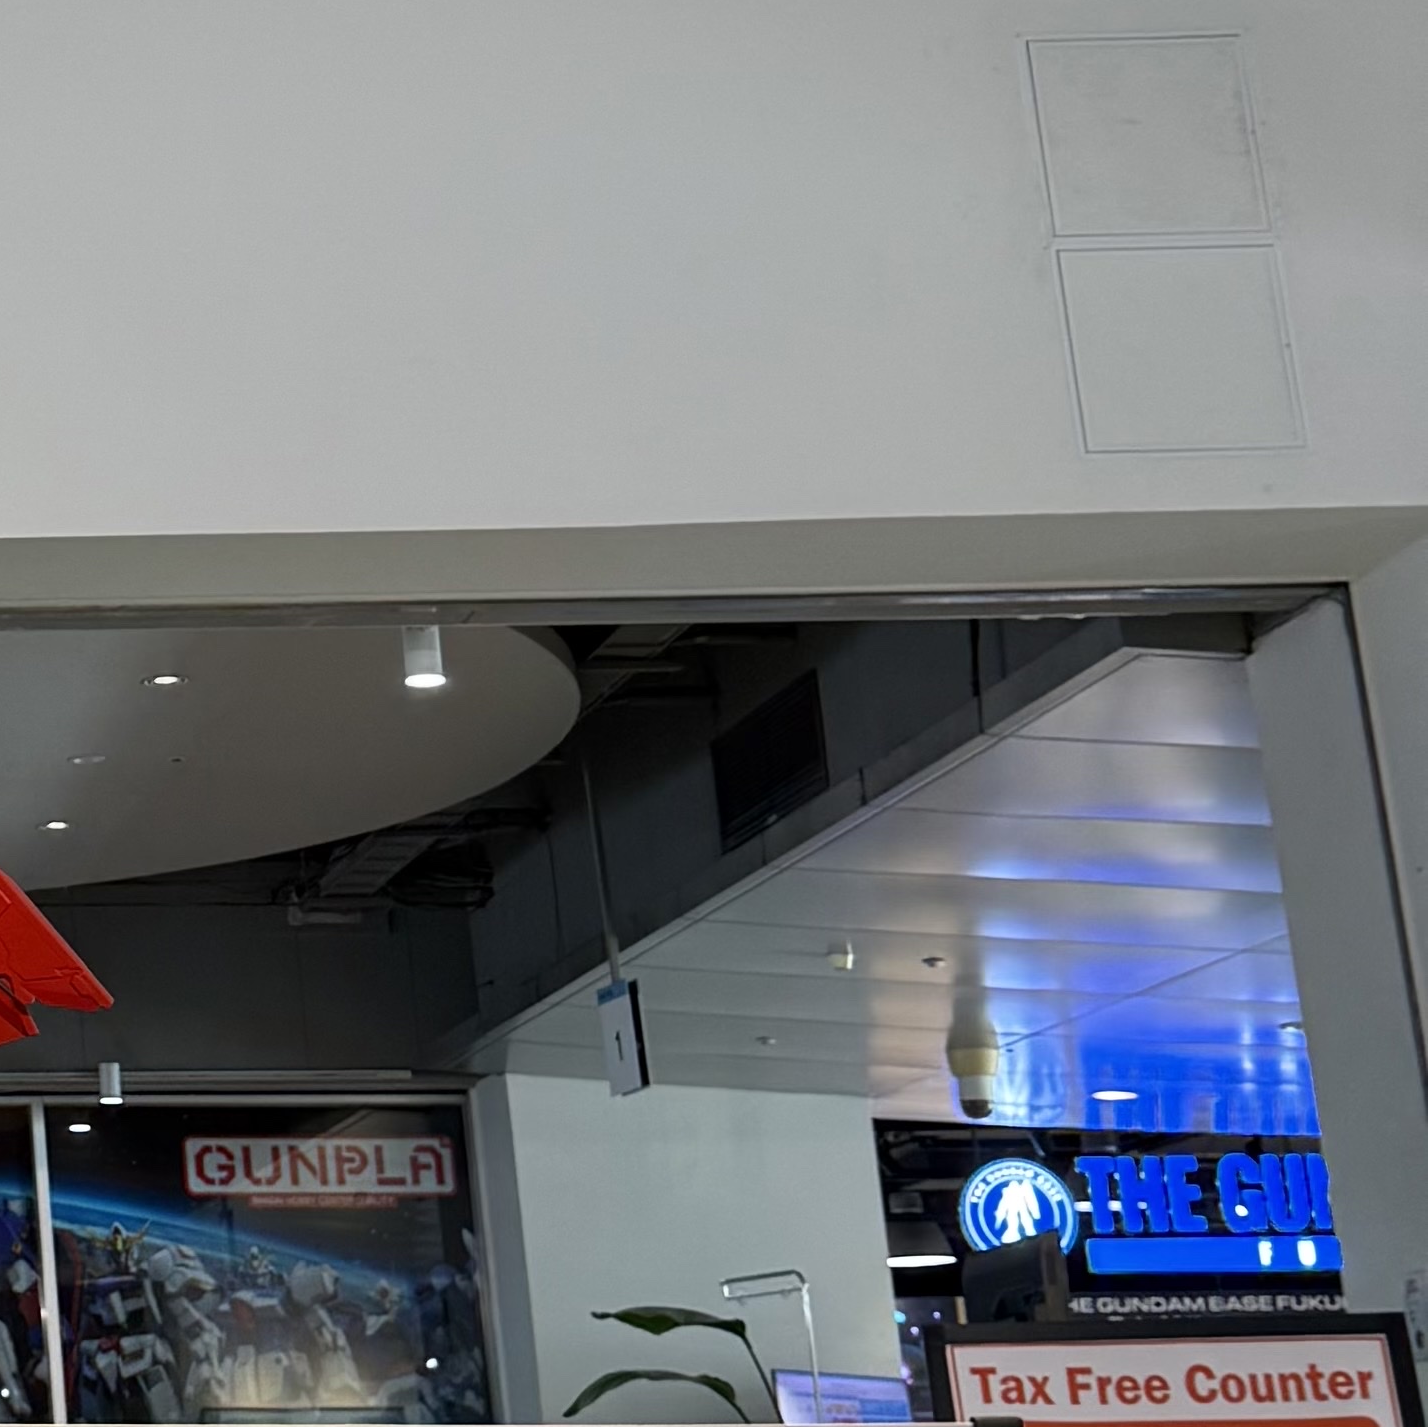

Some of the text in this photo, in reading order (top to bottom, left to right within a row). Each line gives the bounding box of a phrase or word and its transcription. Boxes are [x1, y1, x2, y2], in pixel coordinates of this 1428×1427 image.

[194, 1143, 445, 1187] GUNPLA
[1074, 1154, 1209, 1234] THE
[1096, 1296, 1207, 1314] GUNDAM
[1209, 1294, 1274, 1312] BASE
[969, 1362, 1375, 1406] Tax Free Counter
